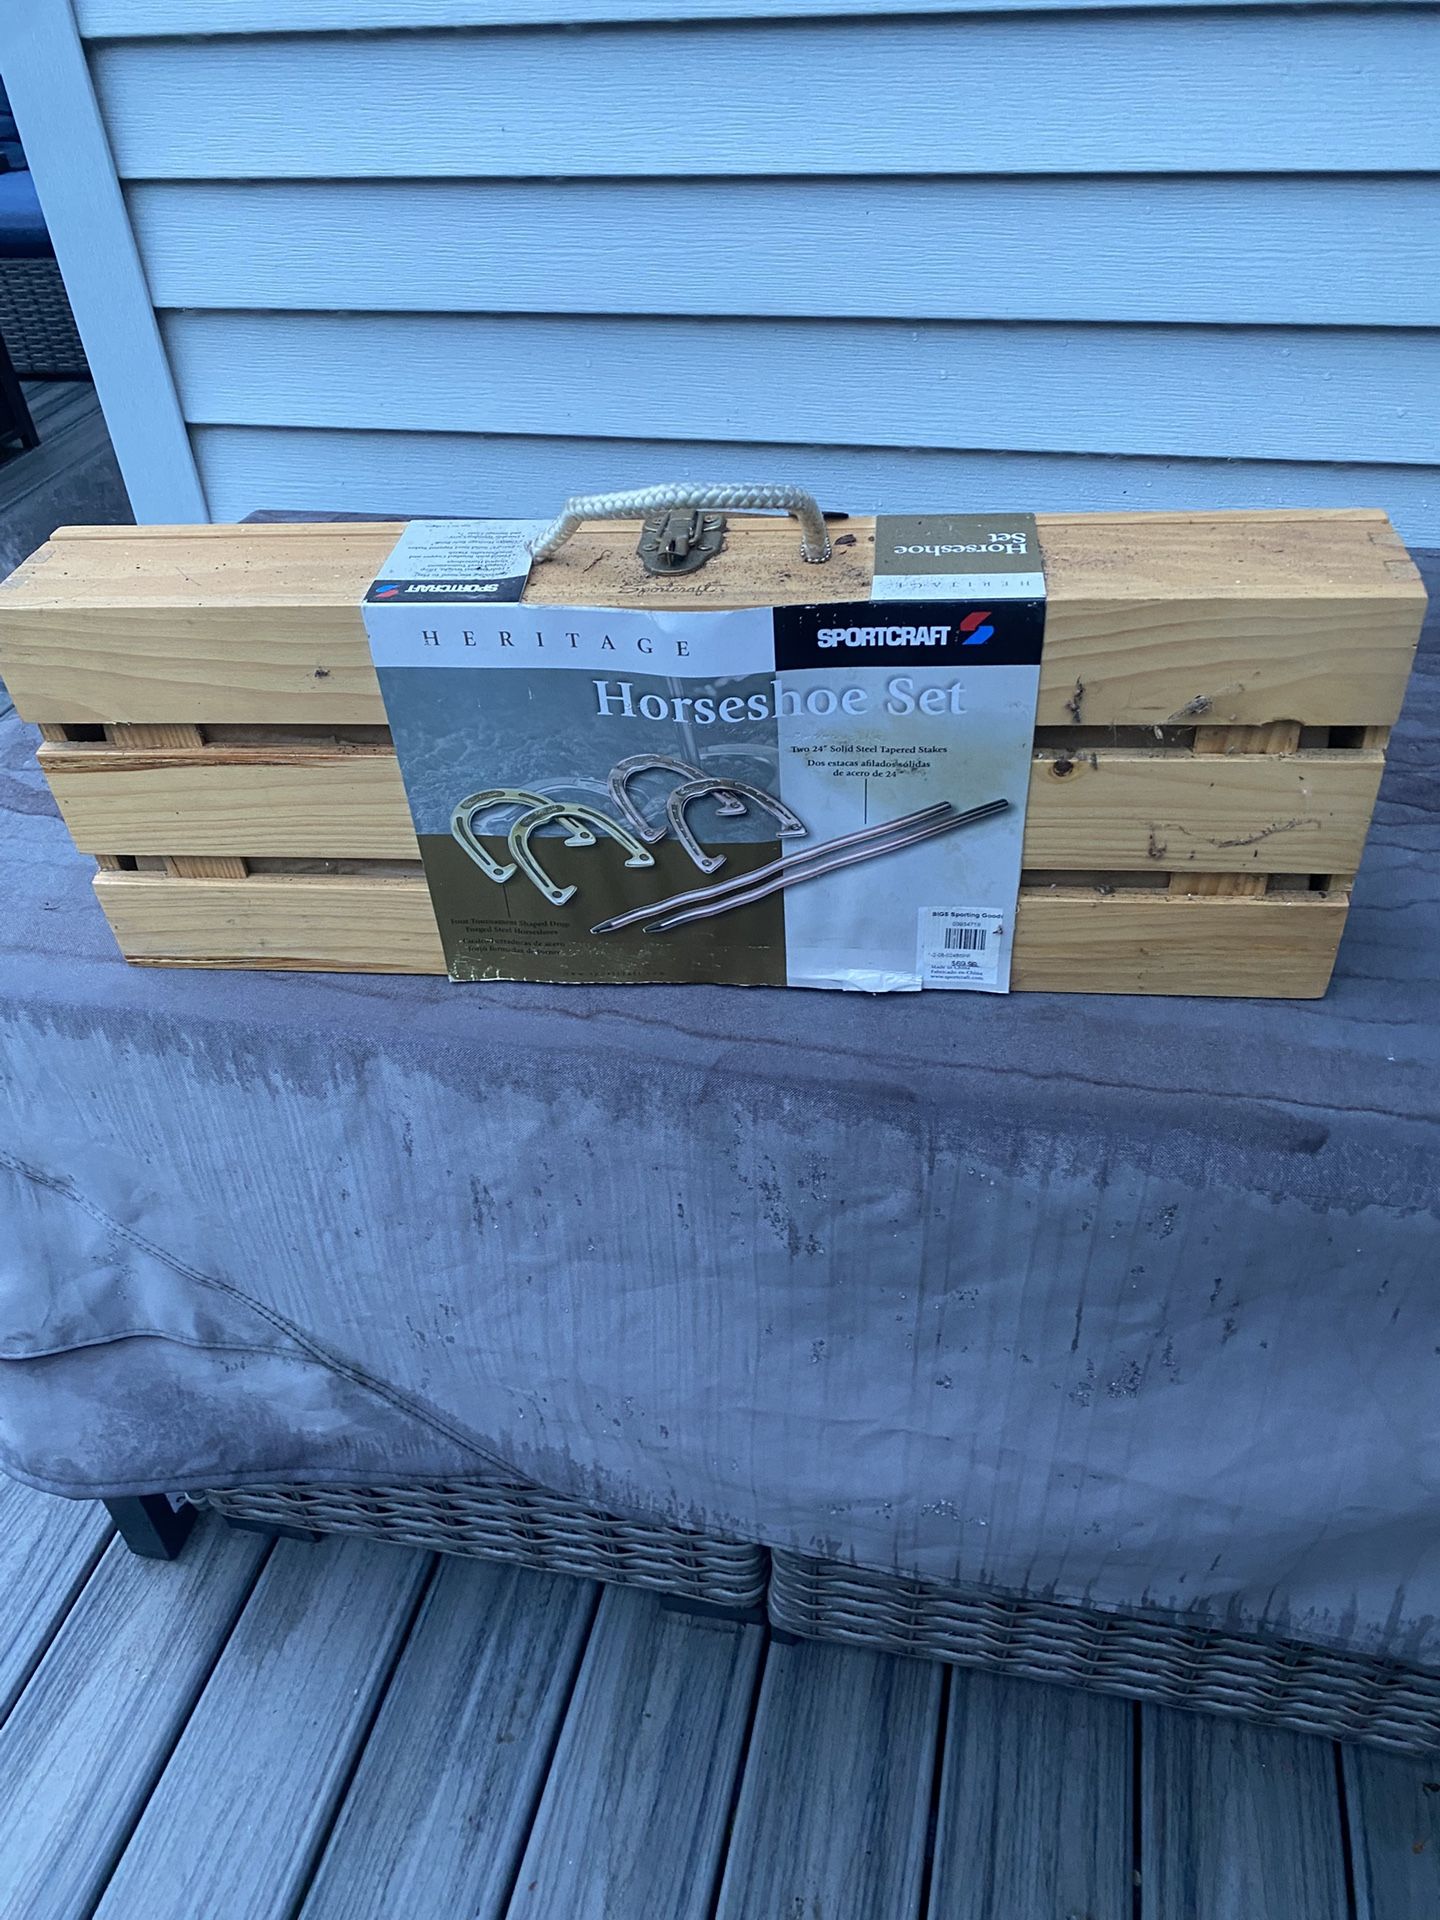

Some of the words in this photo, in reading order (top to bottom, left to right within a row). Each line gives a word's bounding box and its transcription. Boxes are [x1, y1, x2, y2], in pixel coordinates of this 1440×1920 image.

[988, 532, 1027, 544] Set
[894, 543, 1028, 557] Horseshoe
[404, 583, 500, 593] SPORTCRAFT
[817, 625, 951, 648] SPORTCRAFT
[422, 630, 690, 657] HERITAGE
[592, 679, 869, 725] Horseshoe
[886, 677, 968, 716] Set
[791, 745, 810, 753] Two
[830, 744, 855, 753] Solid
[856, 744, 878, 753] Steel
[880, 745, 916, 755] Tapered
[918, 746, 948, 754] Stakes
[807, 759, 826, 767] Dos
[860, 759, 897, 768] afilados
[833, 769, 844, 777] de
[872, 769, 884, 778] de
[950, 911, 980, 919] Sporting
